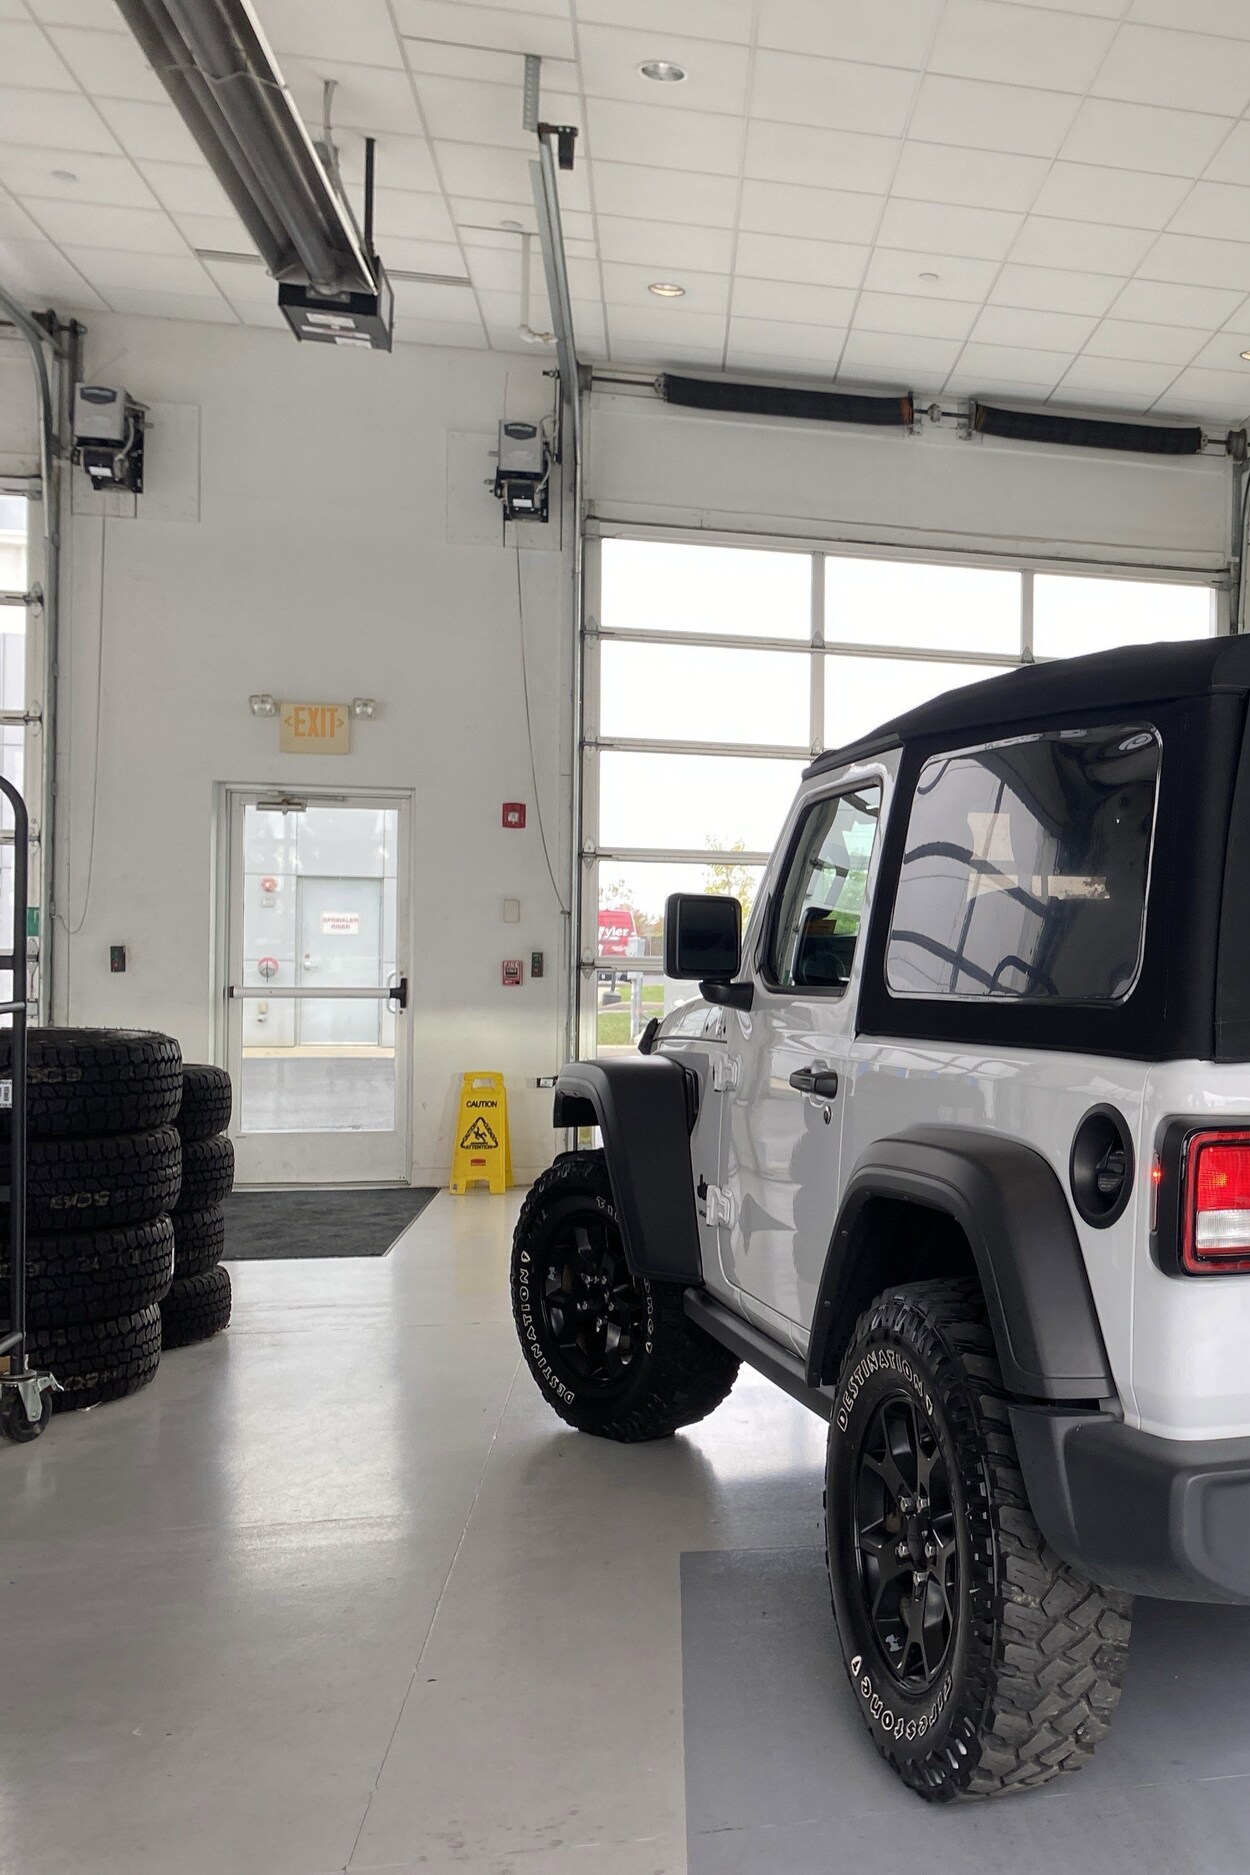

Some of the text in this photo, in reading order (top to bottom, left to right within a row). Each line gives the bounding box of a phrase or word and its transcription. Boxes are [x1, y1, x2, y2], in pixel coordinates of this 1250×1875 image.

[294, 706, 338, 737] EXIT
[466, 1100, 498, 1108] CAUTION
[519, 1268, 575, 1405] DESTINATION
[837, 1349, 924, 1433] DESTINATION
[861, 1669, 952, 1741] Firestone
